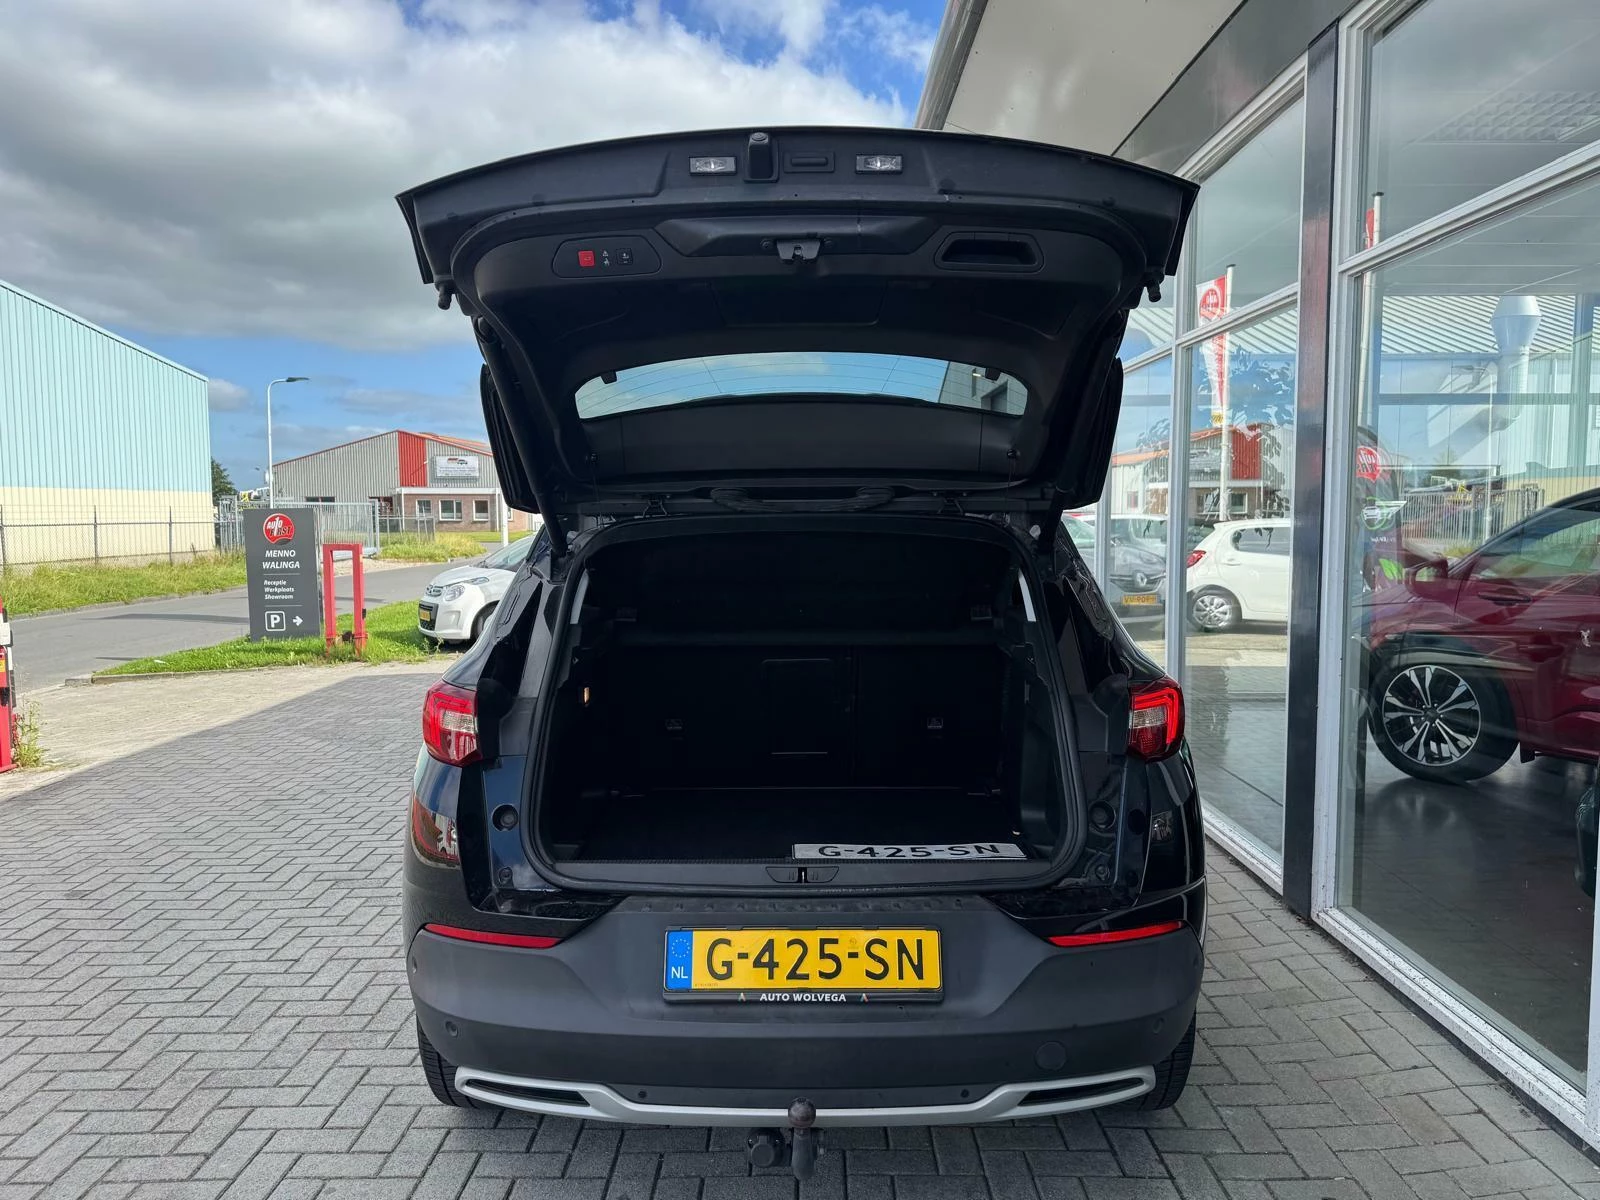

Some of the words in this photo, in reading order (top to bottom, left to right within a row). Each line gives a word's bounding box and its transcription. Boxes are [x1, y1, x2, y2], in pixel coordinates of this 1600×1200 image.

[265, 549, 296, 558] MENNO
[262, 561, 300, 569] WALINGA
[264, 579, 287, 587] Receptie
[270, 614, 281, 628] P
[818, 844, 1000, 858] G-425-SN
[706, 937, 924, 981] G-425-SN
[671, 966, 689, 979] NL
[759, 993, 790, 1002] AUTO
[793, 993, 847, 1002] WOLVEGA
